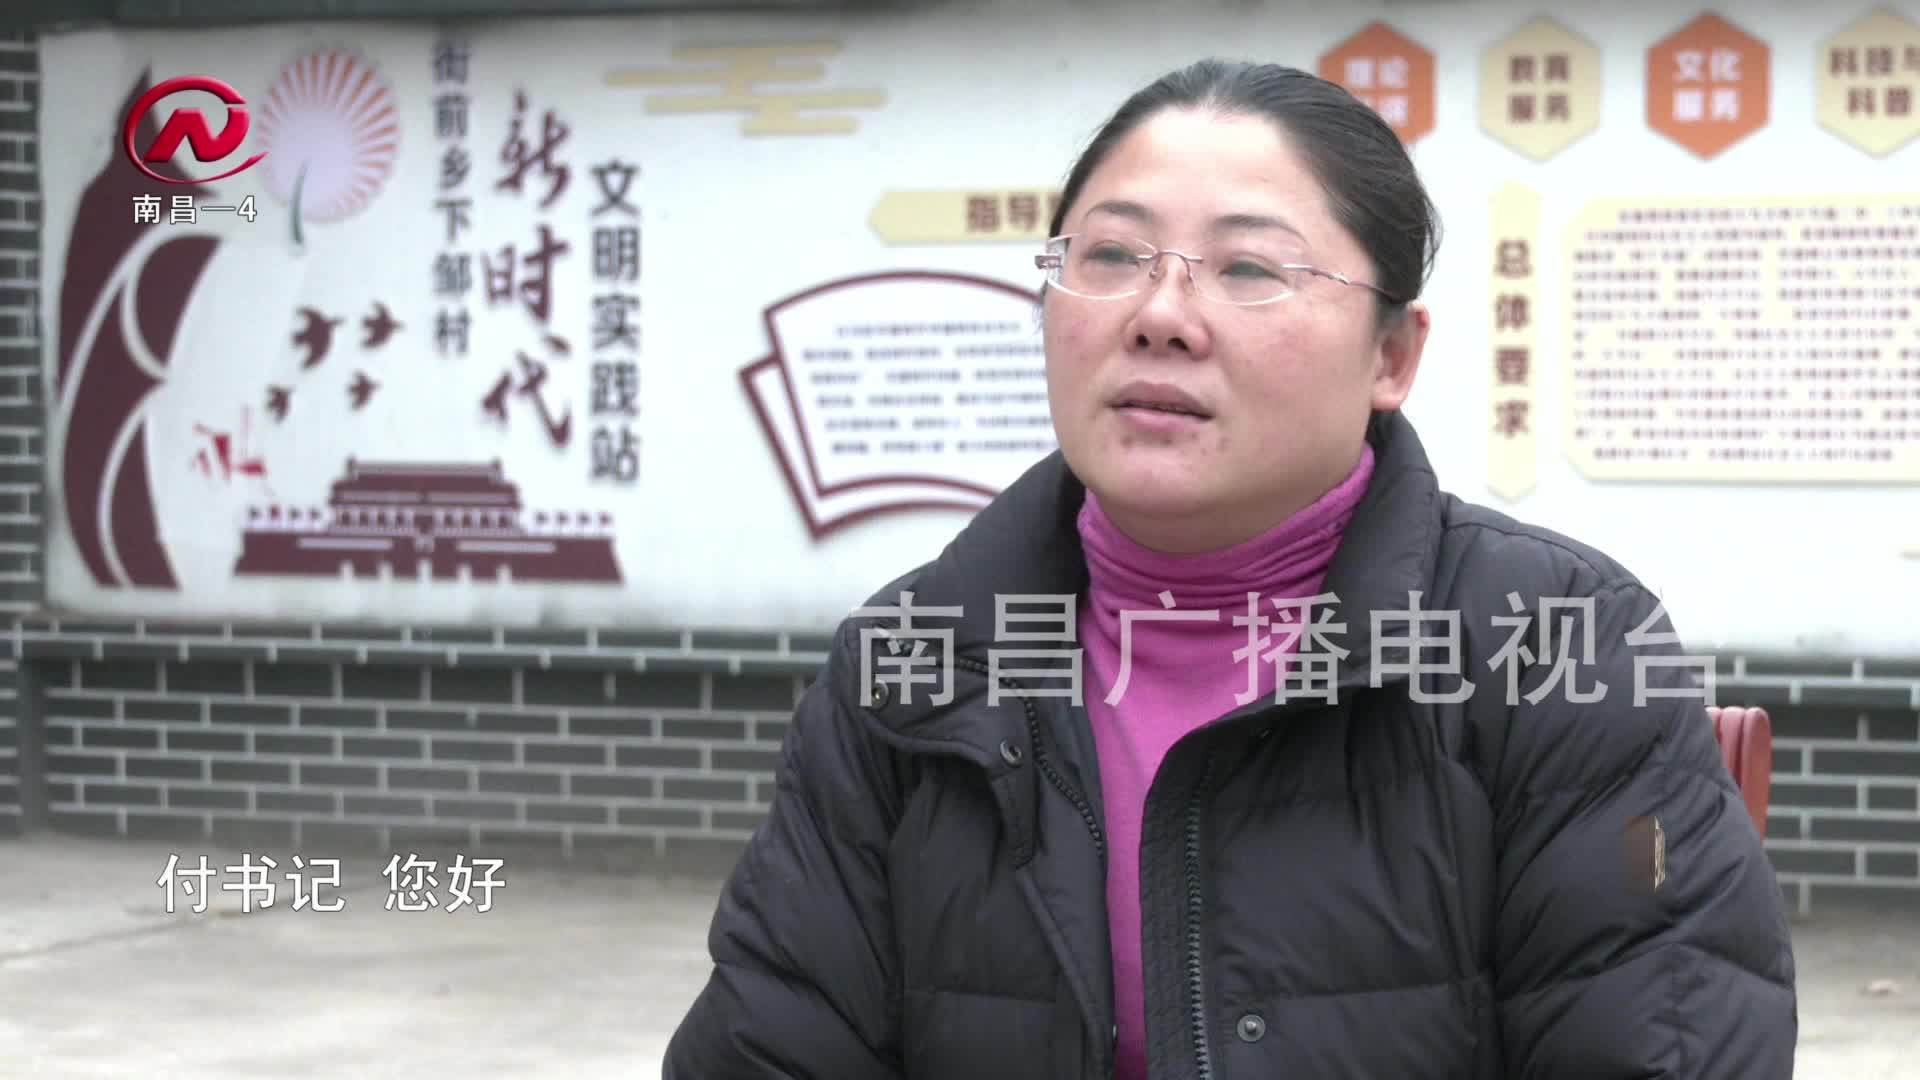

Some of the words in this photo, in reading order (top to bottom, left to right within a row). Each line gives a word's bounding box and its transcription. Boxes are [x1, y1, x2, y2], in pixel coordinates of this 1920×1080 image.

[1674, 50, 1741, 82] 文化
[480, 88, 572, 450] 新时代
[967, 195, 1060, 232] 指导
[590, 161, 640, 484] 文明实践站
[1494, 239, 1531, 438] 总体要求
